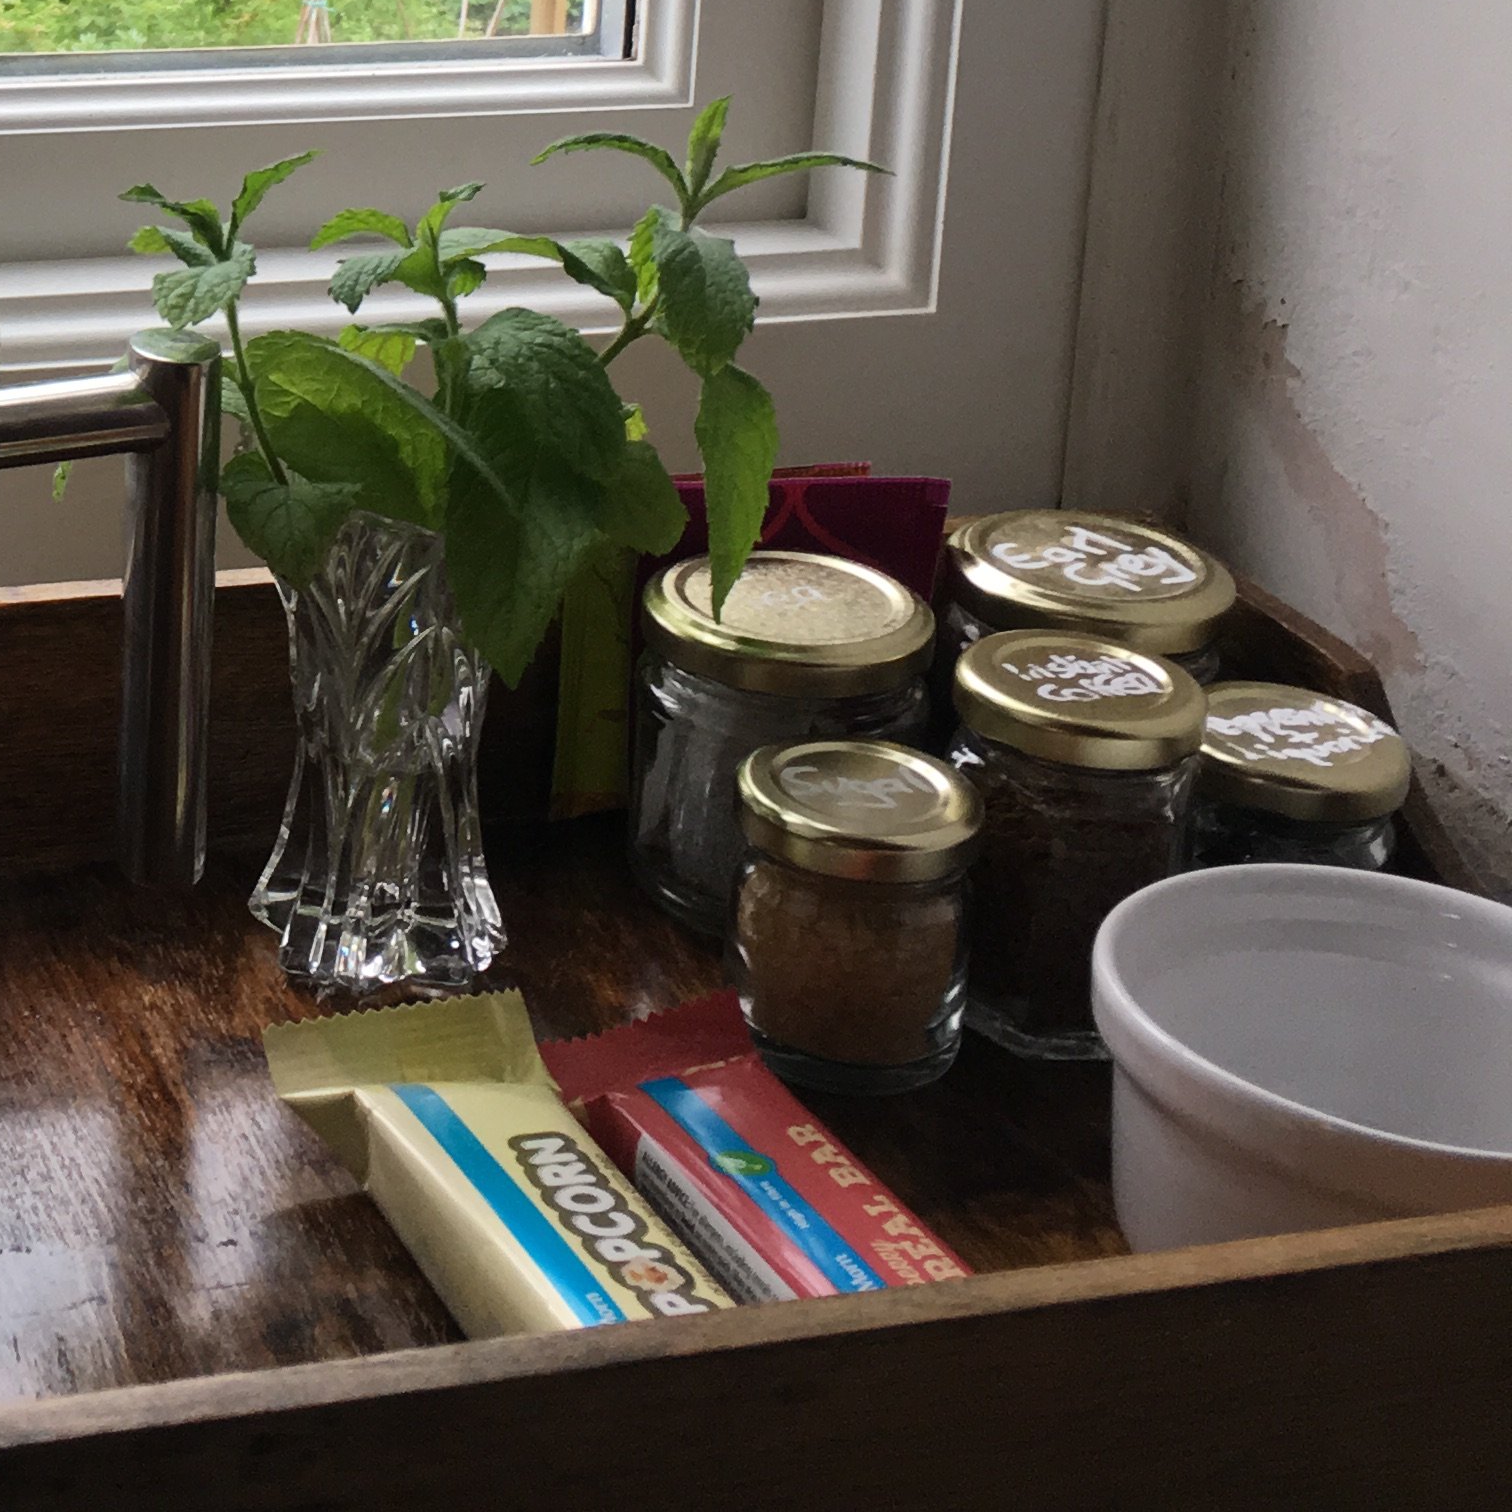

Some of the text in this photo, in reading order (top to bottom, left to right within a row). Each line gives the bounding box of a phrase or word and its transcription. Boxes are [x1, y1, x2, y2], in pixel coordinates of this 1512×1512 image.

[992, 526, 1133, 570] Earl
[1064, 546, 1198, 592] Grey
[781, 765, 937, 809] Sugar
[787, 1124, 872, 1188] BAR
[520, 1137, 710, 1317] POPCORN
